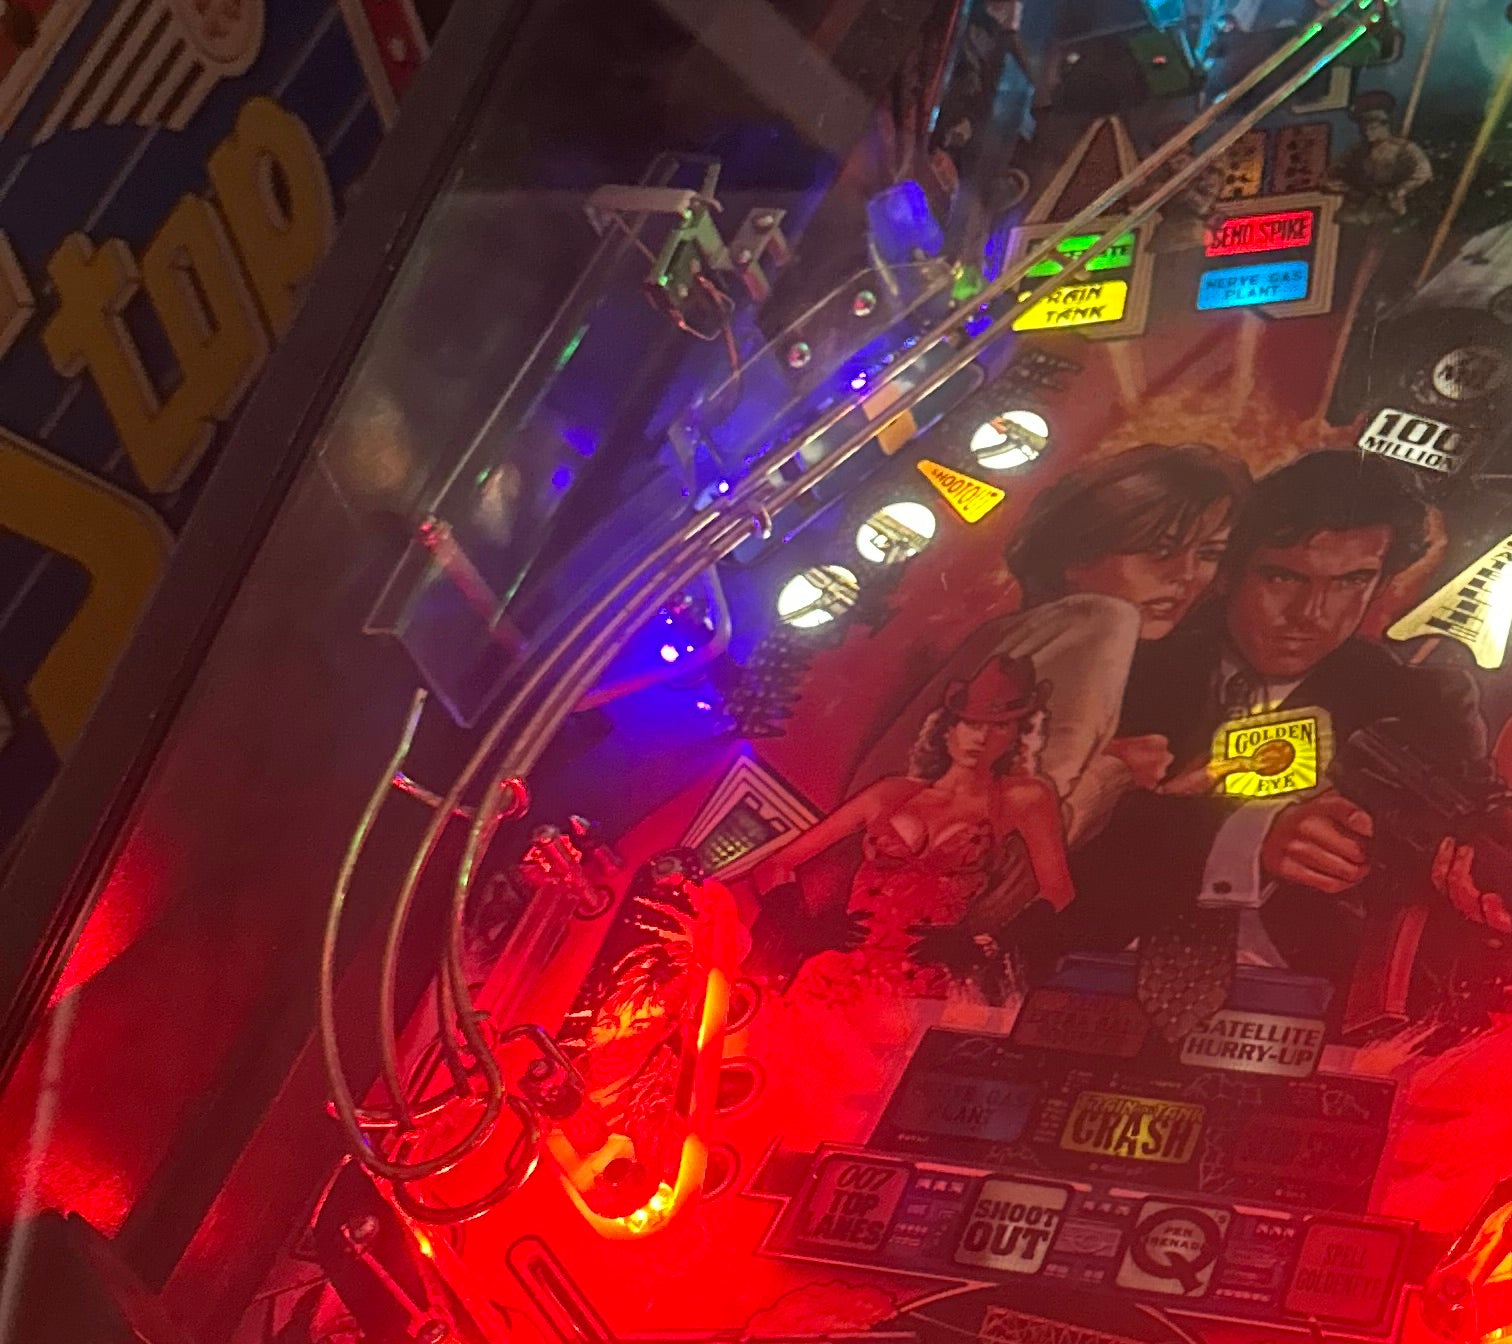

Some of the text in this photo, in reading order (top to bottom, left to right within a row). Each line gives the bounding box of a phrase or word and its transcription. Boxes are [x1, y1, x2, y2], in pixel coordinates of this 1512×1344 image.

[1046, 285, 1102, 304] RAIN
[1234, 722, 1313, 755] GOLDEN
[1257, 771, 1296, 792] EYE
[1198, 1017, 1321, 1047] SATELLITE
[1187, 1038, 1314, 1066] HURRY-UP
[1071, 1108, 1191, 1158] CRASH
[836, 1164, 896, 1192] 007
[975, 1197, 1061, 1229] SHOOT
[965, 1222, 1051, 1260] OUT
